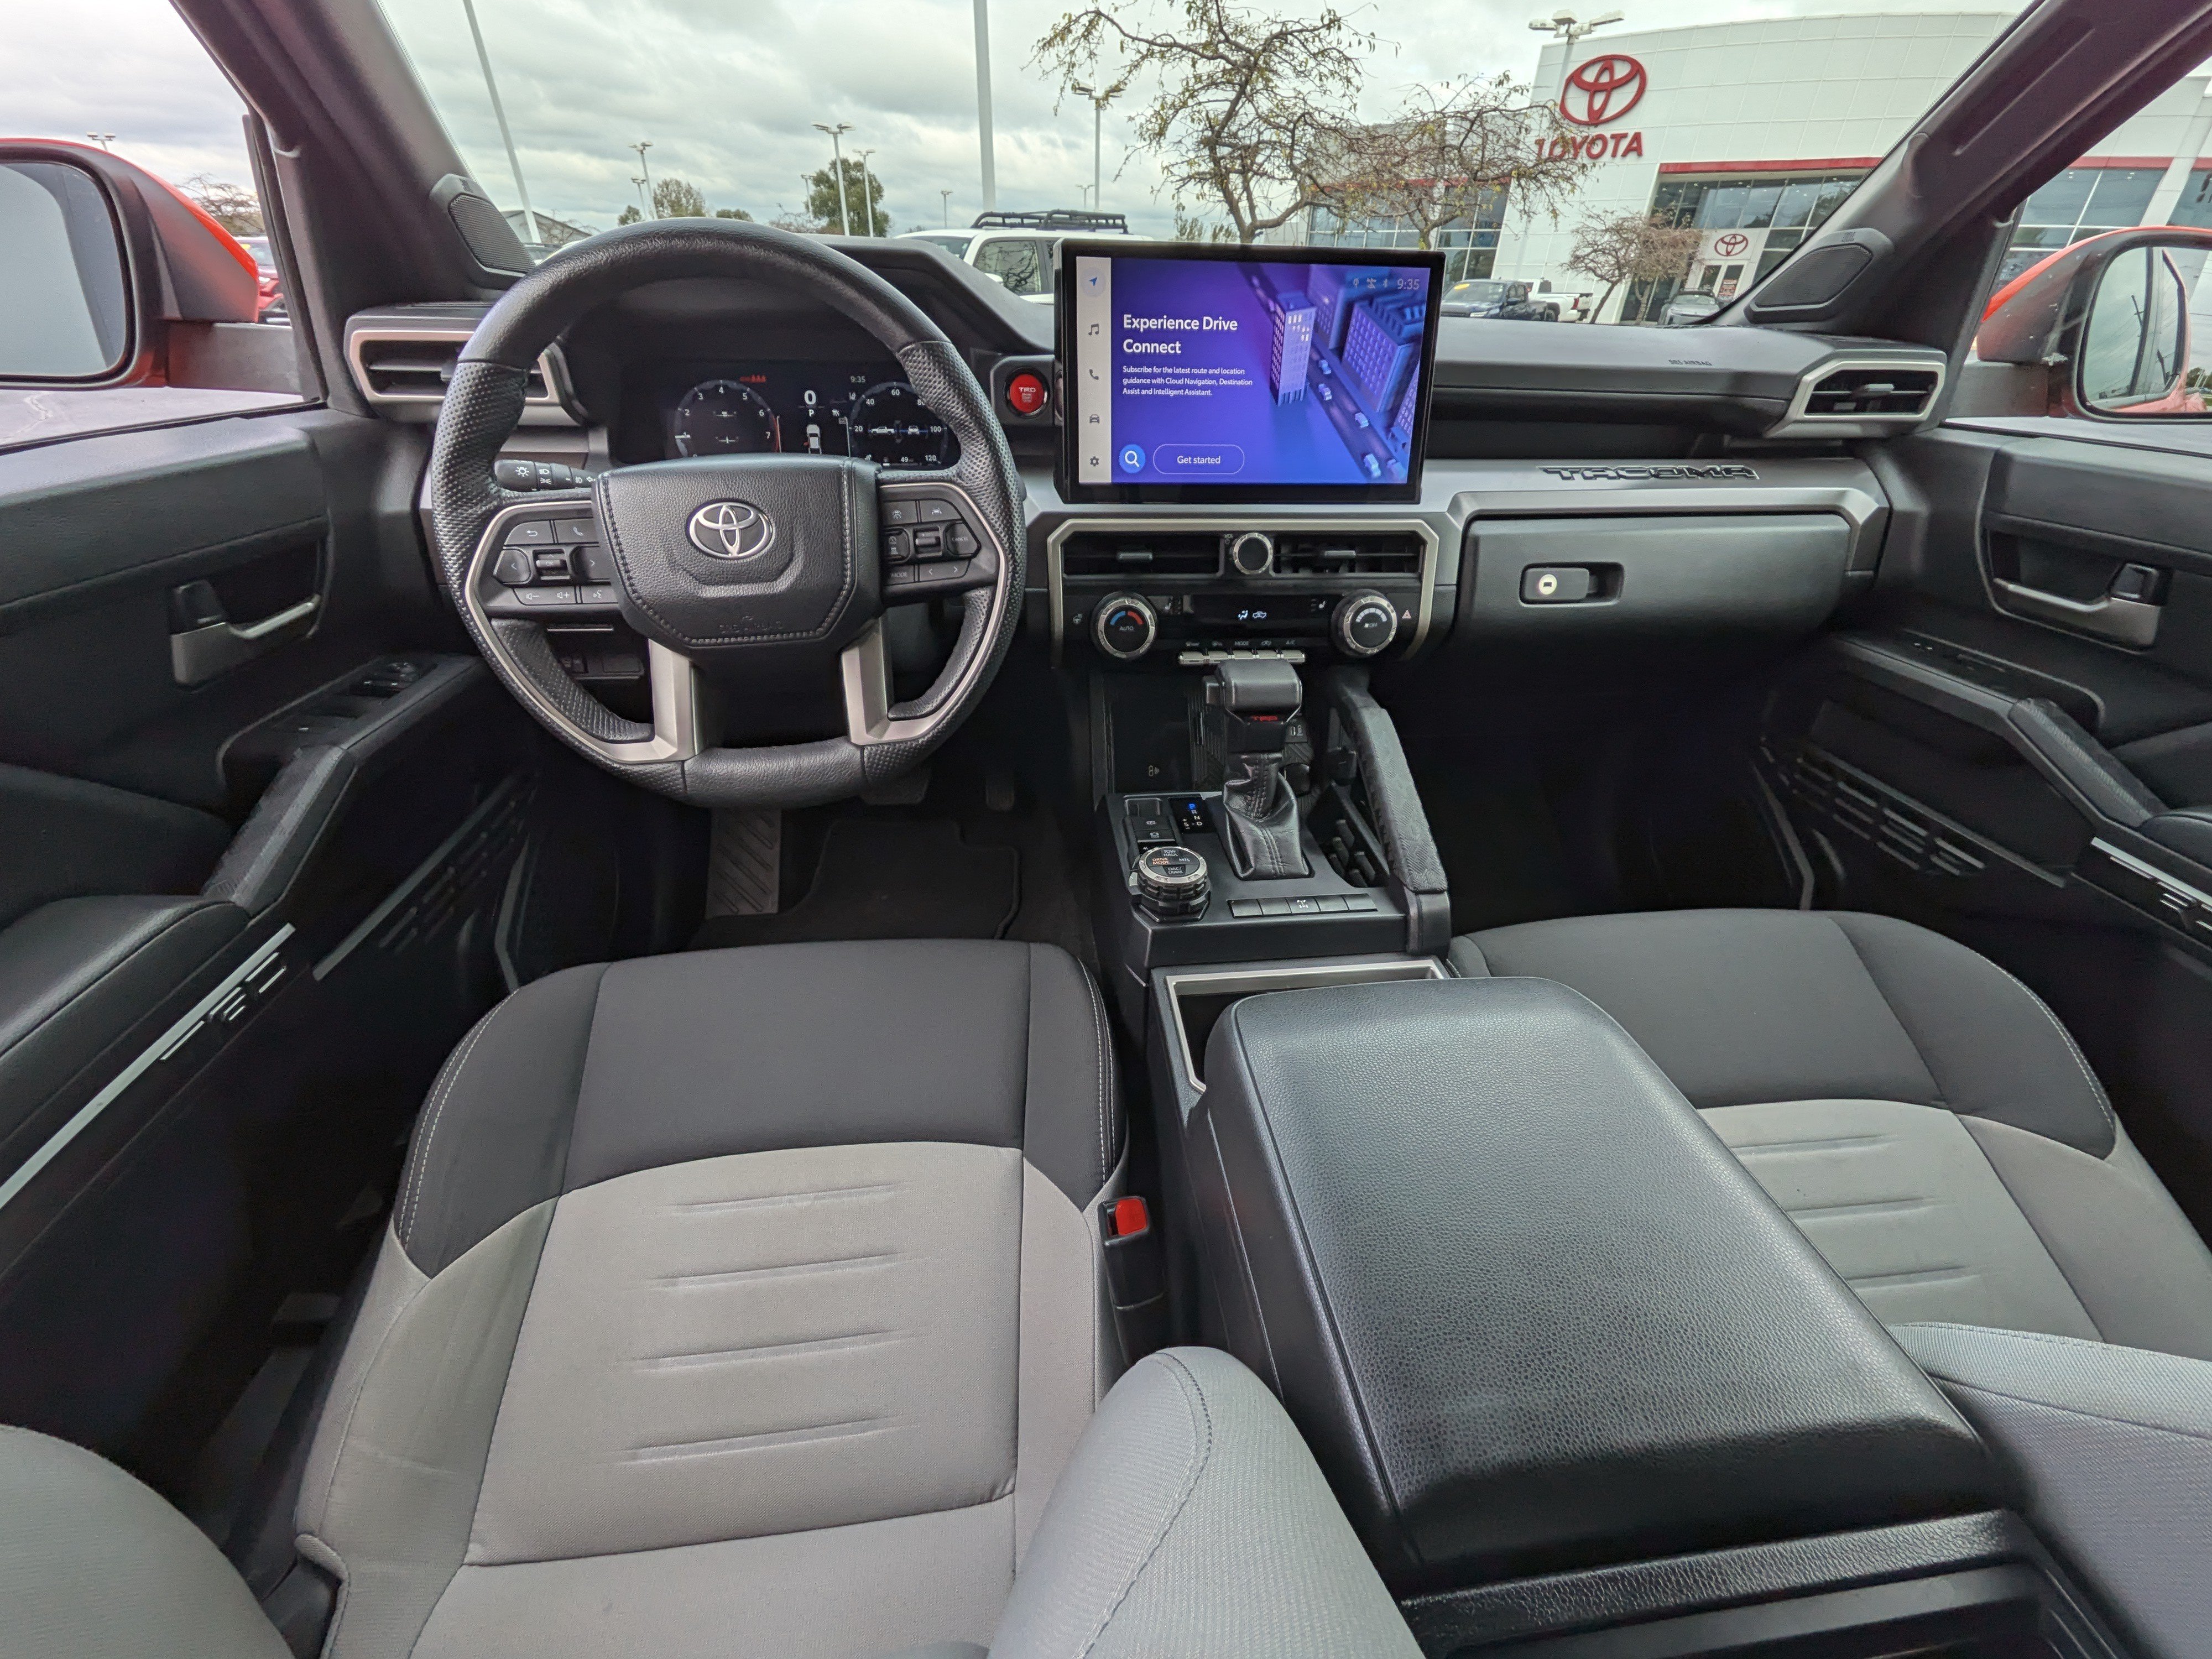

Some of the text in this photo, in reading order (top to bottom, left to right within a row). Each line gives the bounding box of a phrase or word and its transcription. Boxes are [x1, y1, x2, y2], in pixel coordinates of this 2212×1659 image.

[1535, 132, 1643, 160] TOYOTA
[1397, 279, 1420, 290] 9:35
[1123, 314, 1238, 332] Experience Drive
[1123, 338, 1181, 353] Connect
[1123, 377, 1151, 385] guidance
[1185, 378, 1218, 386] Navigation,
[804, 390, 817, 405] 0
[1154, 388, 1183, 397] Intelligent
[808, 409, 815, 417] P
[765, 431, 771, 439] 7
[1177, 455, 1220, 464] Get started
[1536, 465, 1760, 480] TACOMA
